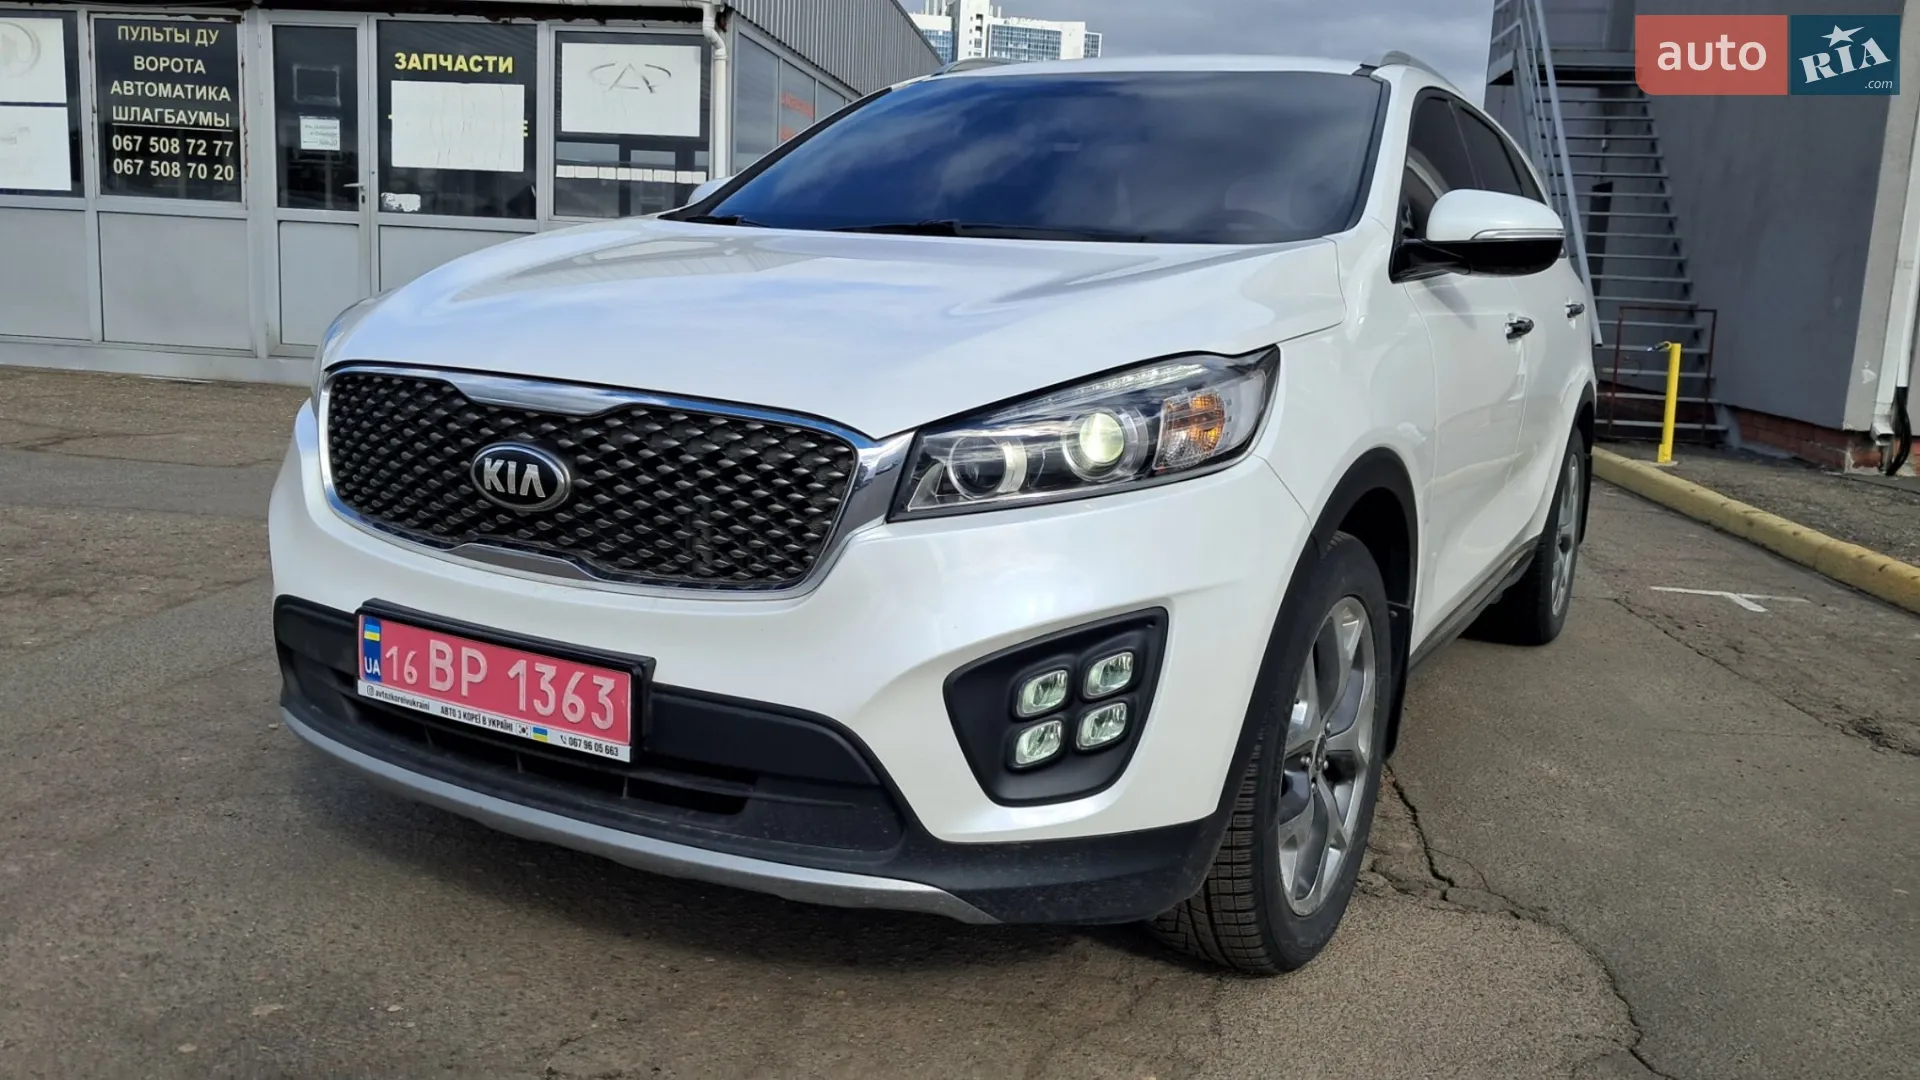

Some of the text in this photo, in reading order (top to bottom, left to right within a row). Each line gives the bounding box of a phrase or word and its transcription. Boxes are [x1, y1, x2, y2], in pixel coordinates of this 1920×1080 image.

[117, 25, 219, 47] ПУЛЬТЫ ДУ
[133, 55, 206, 74] ВОРОТА
[394, 52, 513, 74] ЗАПЧАСТИ
[110, 80, 231, 101] АВТОМАТИКА
[112, 105, 230, 127] ШЛАГБАУМЫ
[112, 134, 234, 157] 067 508 72 77
[113, 158, 234, 181] 067 508 70 20
[483, 457, 546, 498] KIA
[364, 656, 381, 676] UA
[385, 639, 615, 730] 16 BP 1363
[441, 706, 456, 717] АВТО
[463, 711, 481, 724] КОРЕЇ
[482, 716, 487, 725] В
[488, 718, 513, 732] УКРАЇНІ
[568, 736, 619, 756] 067 96 05 663
